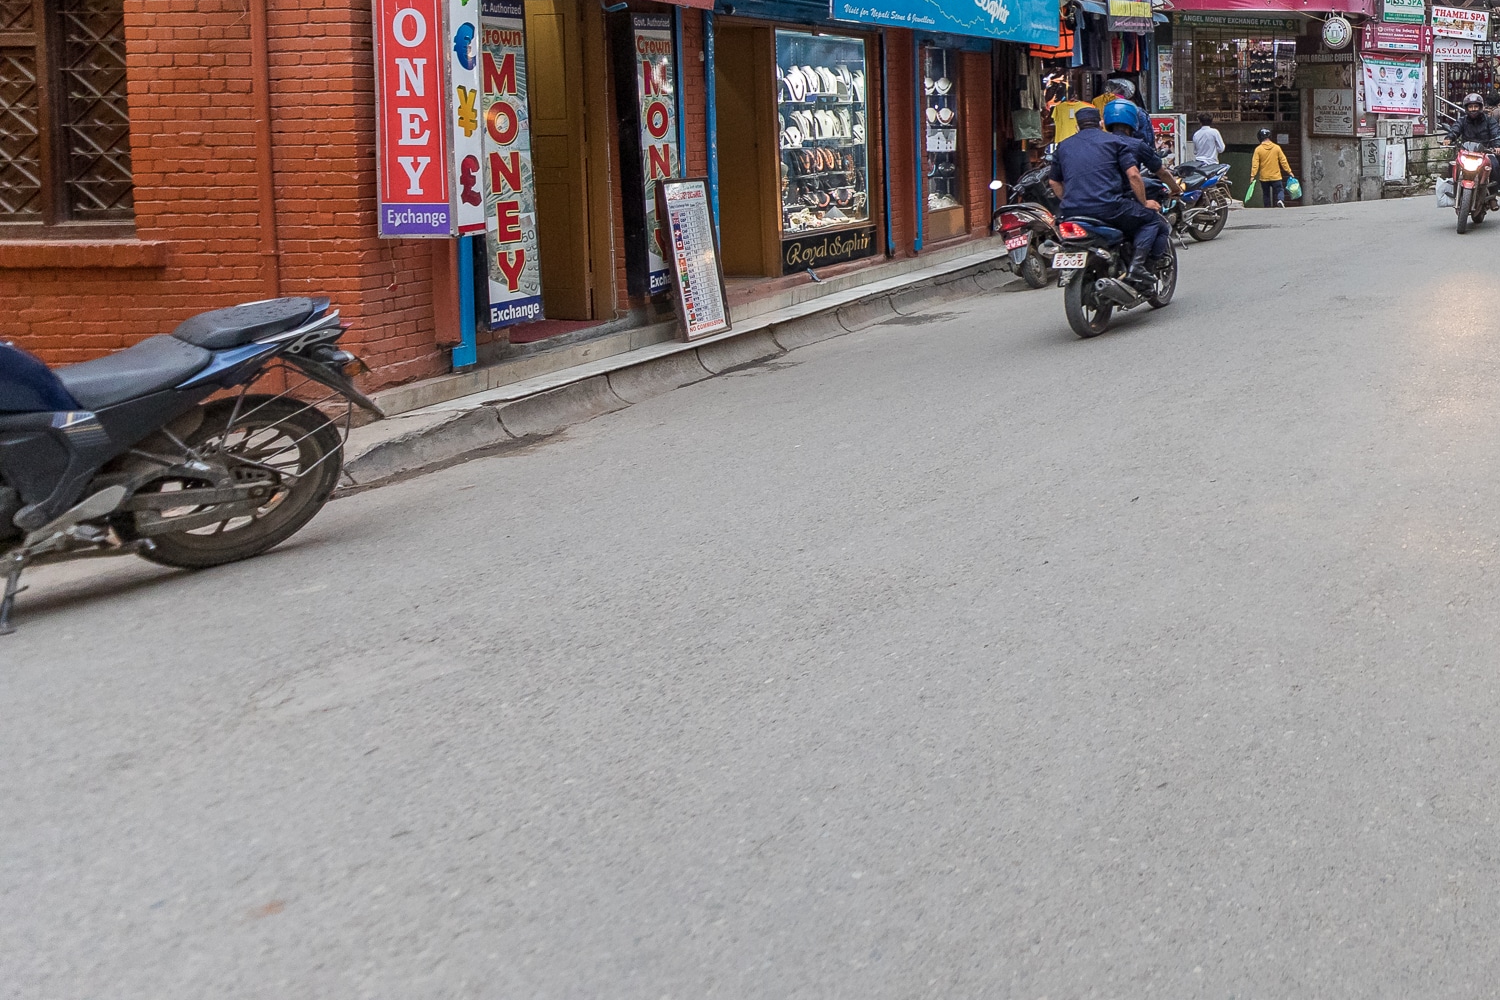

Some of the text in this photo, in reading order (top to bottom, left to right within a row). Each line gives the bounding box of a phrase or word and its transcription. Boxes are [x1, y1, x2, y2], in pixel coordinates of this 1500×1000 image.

[489, 3, 522, 16] Authorized
[843, 3, 859, 15] Visit
[860, 6, 869, 17] for
[870, 7, 890, 22] Nepali
[890, 11, 906, 22] Stone
[1434, 8, 1469, 20] THAMEL
[1470, 11, 1486, 21] SPA
[1183, 14, 1285, 27] ANGEL MONEY EXCHANGE PVT. LTD.
[636, 34, 672, 55] Crown
[1334, 52, 1353, 62] COFFEE
[482, 52, 527, 293] MONEY
[387, 208, 447, 228] Exchange
[786, 241, 828, 267] Royal
[650, 273, 671, 290] Excha
[490, 301, 540, 324] Exchange
[697, 318, 725, 332] COMMISSION
